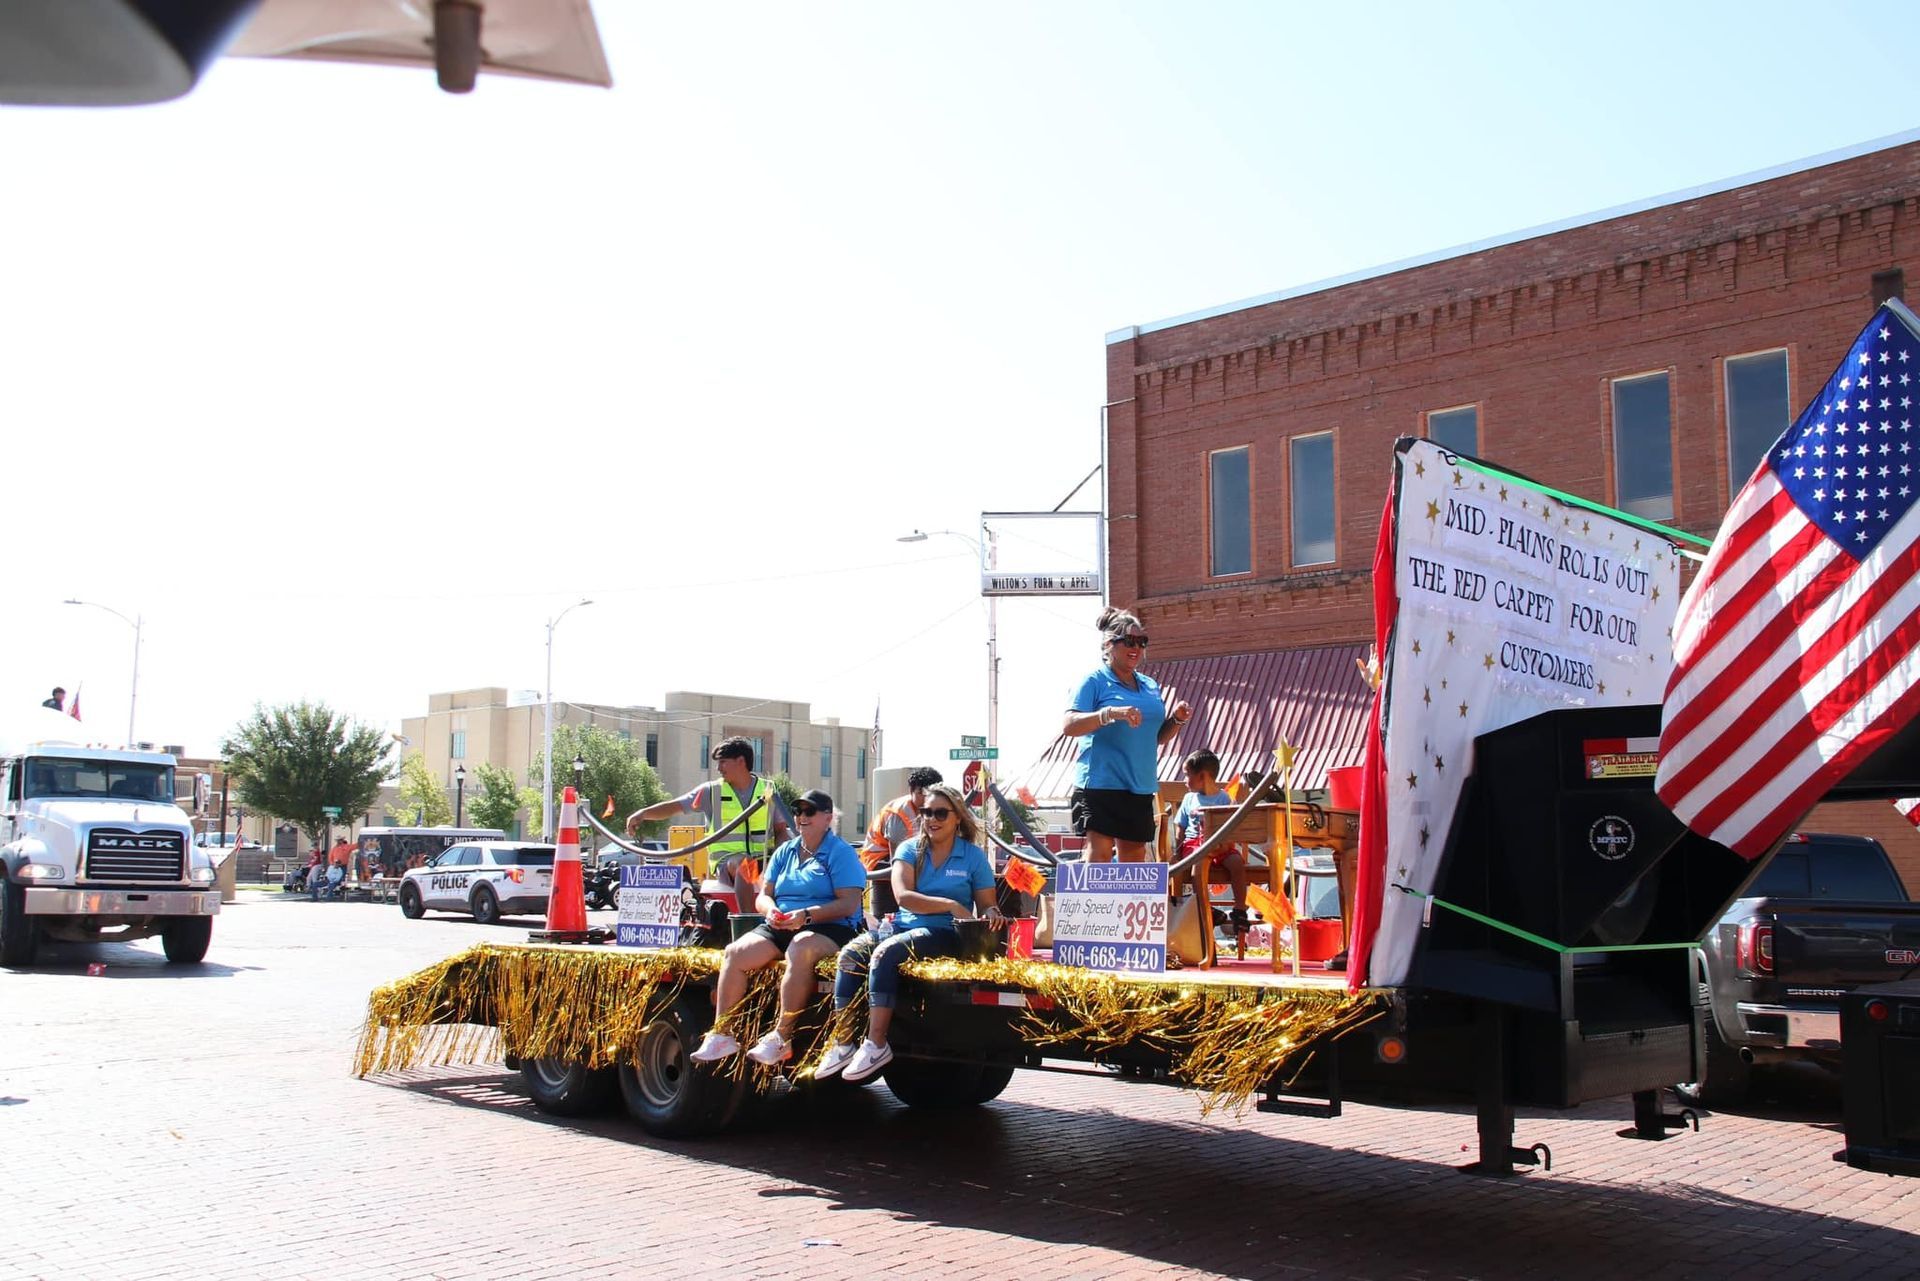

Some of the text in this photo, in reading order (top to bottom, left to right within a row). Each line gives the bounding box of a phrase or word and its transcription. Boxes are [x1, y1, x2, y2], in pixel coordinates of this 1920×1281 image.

[1558, 544, 1609, 584] ROLLS
[1616, 565, 1649, 596] OUT
[992, 577, 1027, 589] WILTON'S
[1034, 577, 1053, 588] FURN
[1071, 577, 1089, 588] APPL
[1409, 556, 1638, 647] THE RED CARPET FOR OUR
[1500, 641, 1594, 690] CUSTOMERS
[959, 750, 989, 759] BROADWAY
[98, 838, 174, 848] MACK
[444, 836, 452, 847] IF
[431, 874, 470, 890] POLICE
[1065, 863, 1158, 891] MID-PLAINS
[1059, 899, 1114, 917] High Speed
[620, 926, 675, 946] 806-668-4420
[1055, 920, 1119, 937] Fiber Internet
[1059, 945, 1159, 970] 806-668-4420
[1885, 950, 1920, 963] GM
